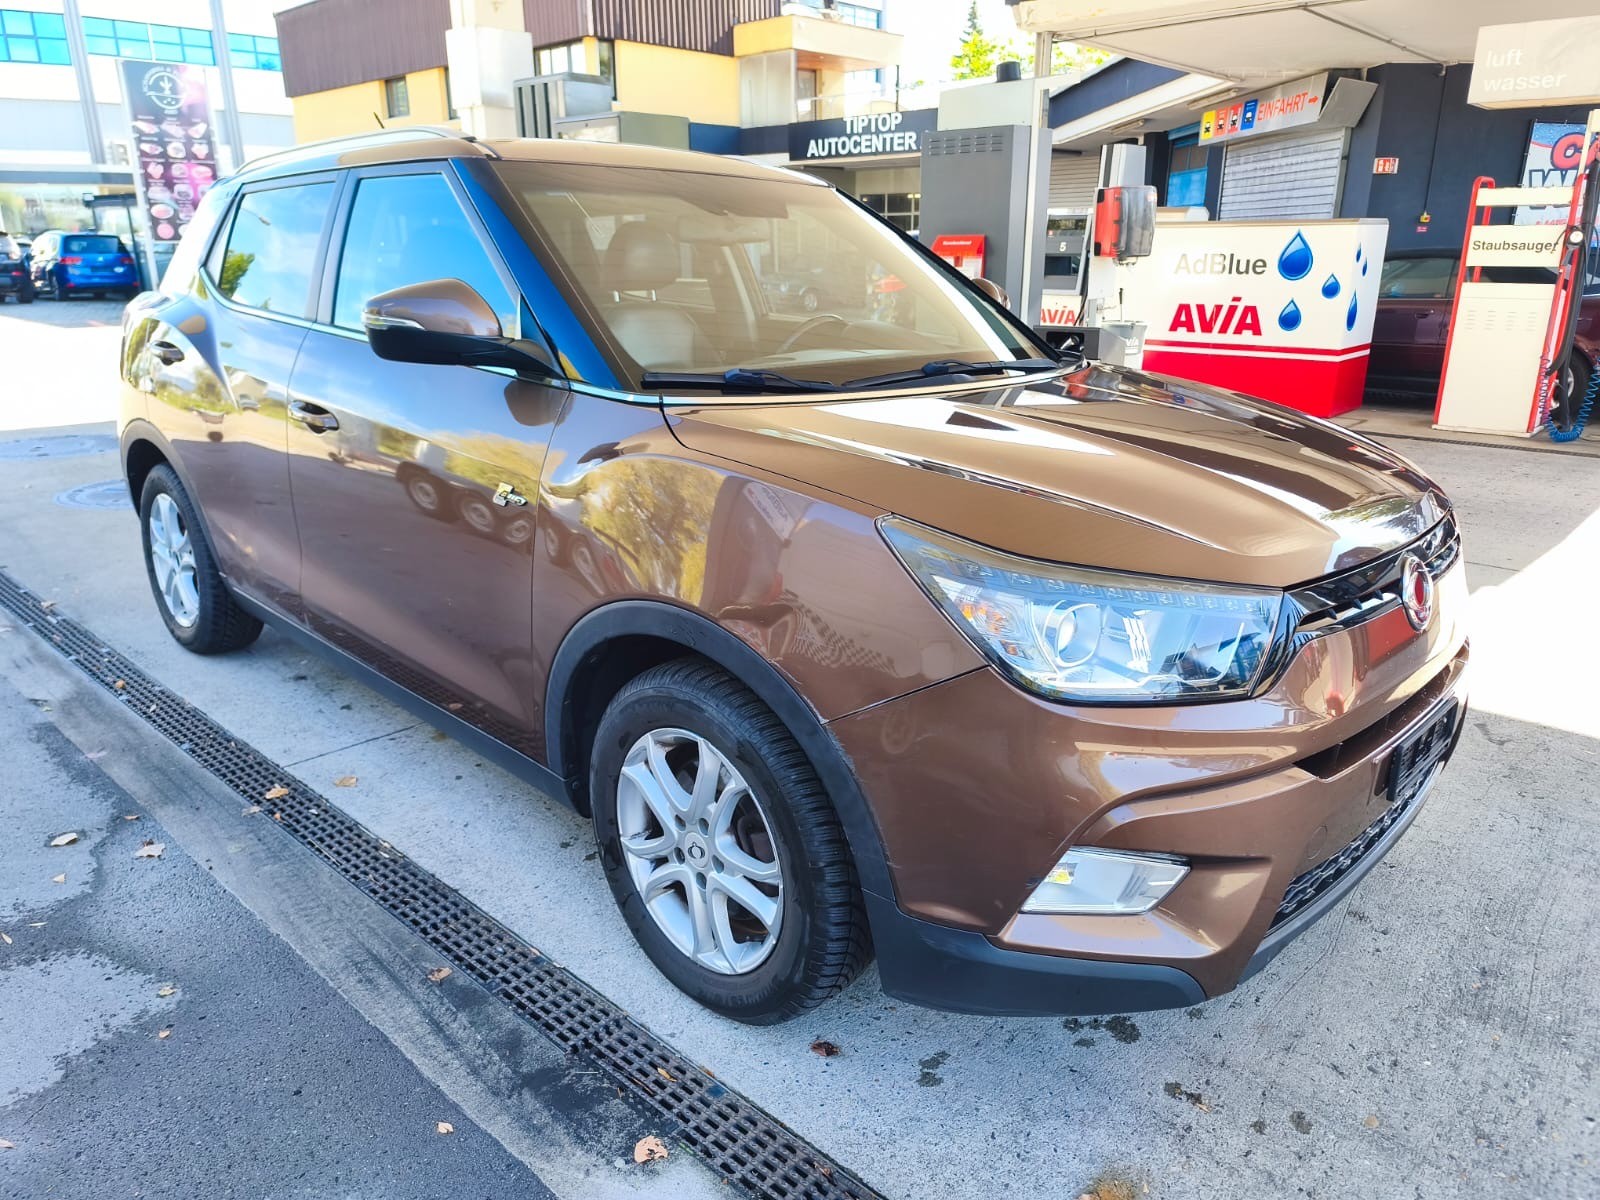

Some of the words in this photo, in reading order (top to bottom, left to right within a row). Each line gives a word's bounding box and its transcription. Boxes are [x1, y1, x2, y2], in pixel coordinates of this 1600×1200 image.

[1485, 48, 1523, 69] luft
[1483, 73, 1567, 92] wasser
[1257, 92, 1308, 121] EINFAHRT
[843, 112, 903, 134] TIPTOP
[806, 131, 917, 157] AUTOCENTER
[1059, 241, 1067, 251] 5
[1472, 240, 1558, 253] Staubsauger
[1174, 253, 1267, 275] AdBlue
[1168, 296, 1262, 336] AVIA
